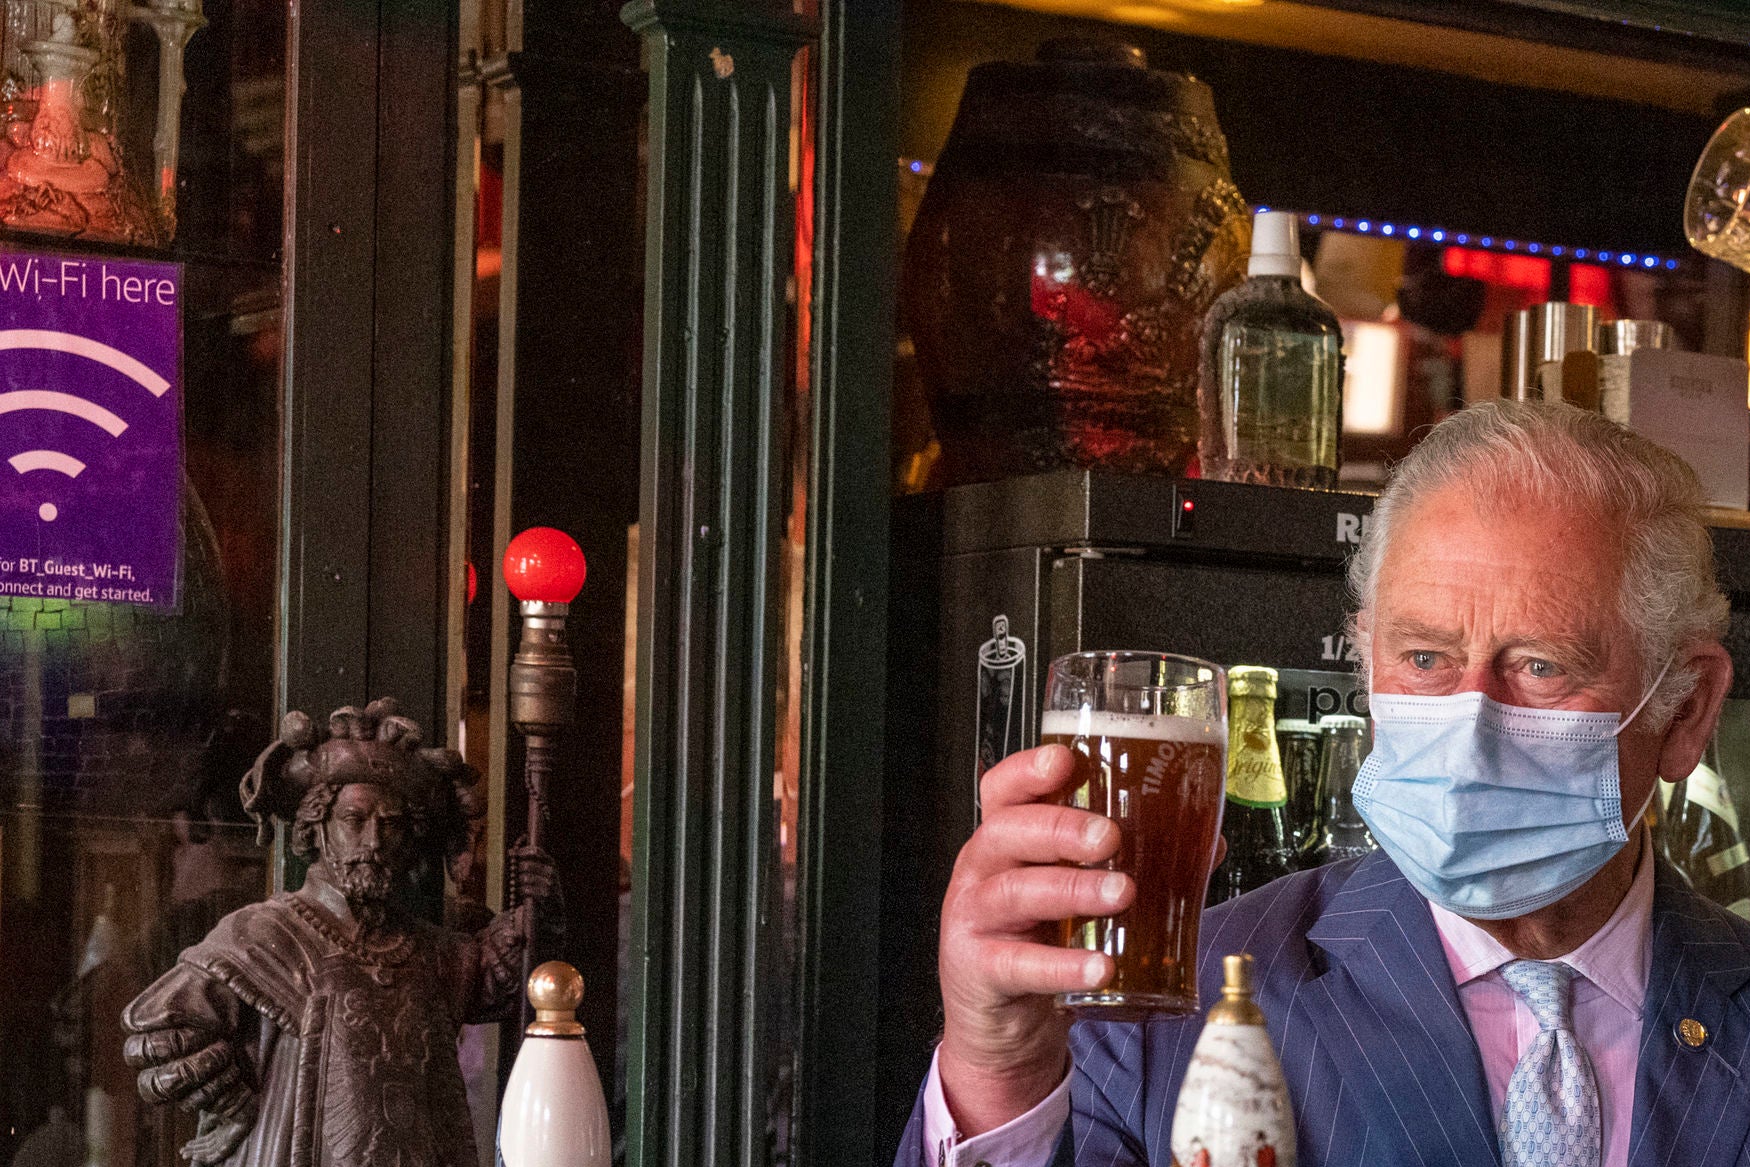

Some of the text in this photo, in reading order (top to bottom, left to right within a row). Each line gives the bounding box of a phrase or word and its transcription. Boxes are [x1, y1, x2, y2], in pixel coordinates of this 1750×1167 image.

[0, 258, 175, 305] Wi-Fi here
[47, 584, 72, 597] and
[75, 587, 98, 600] get
[101, 588, 153, 602] started.
